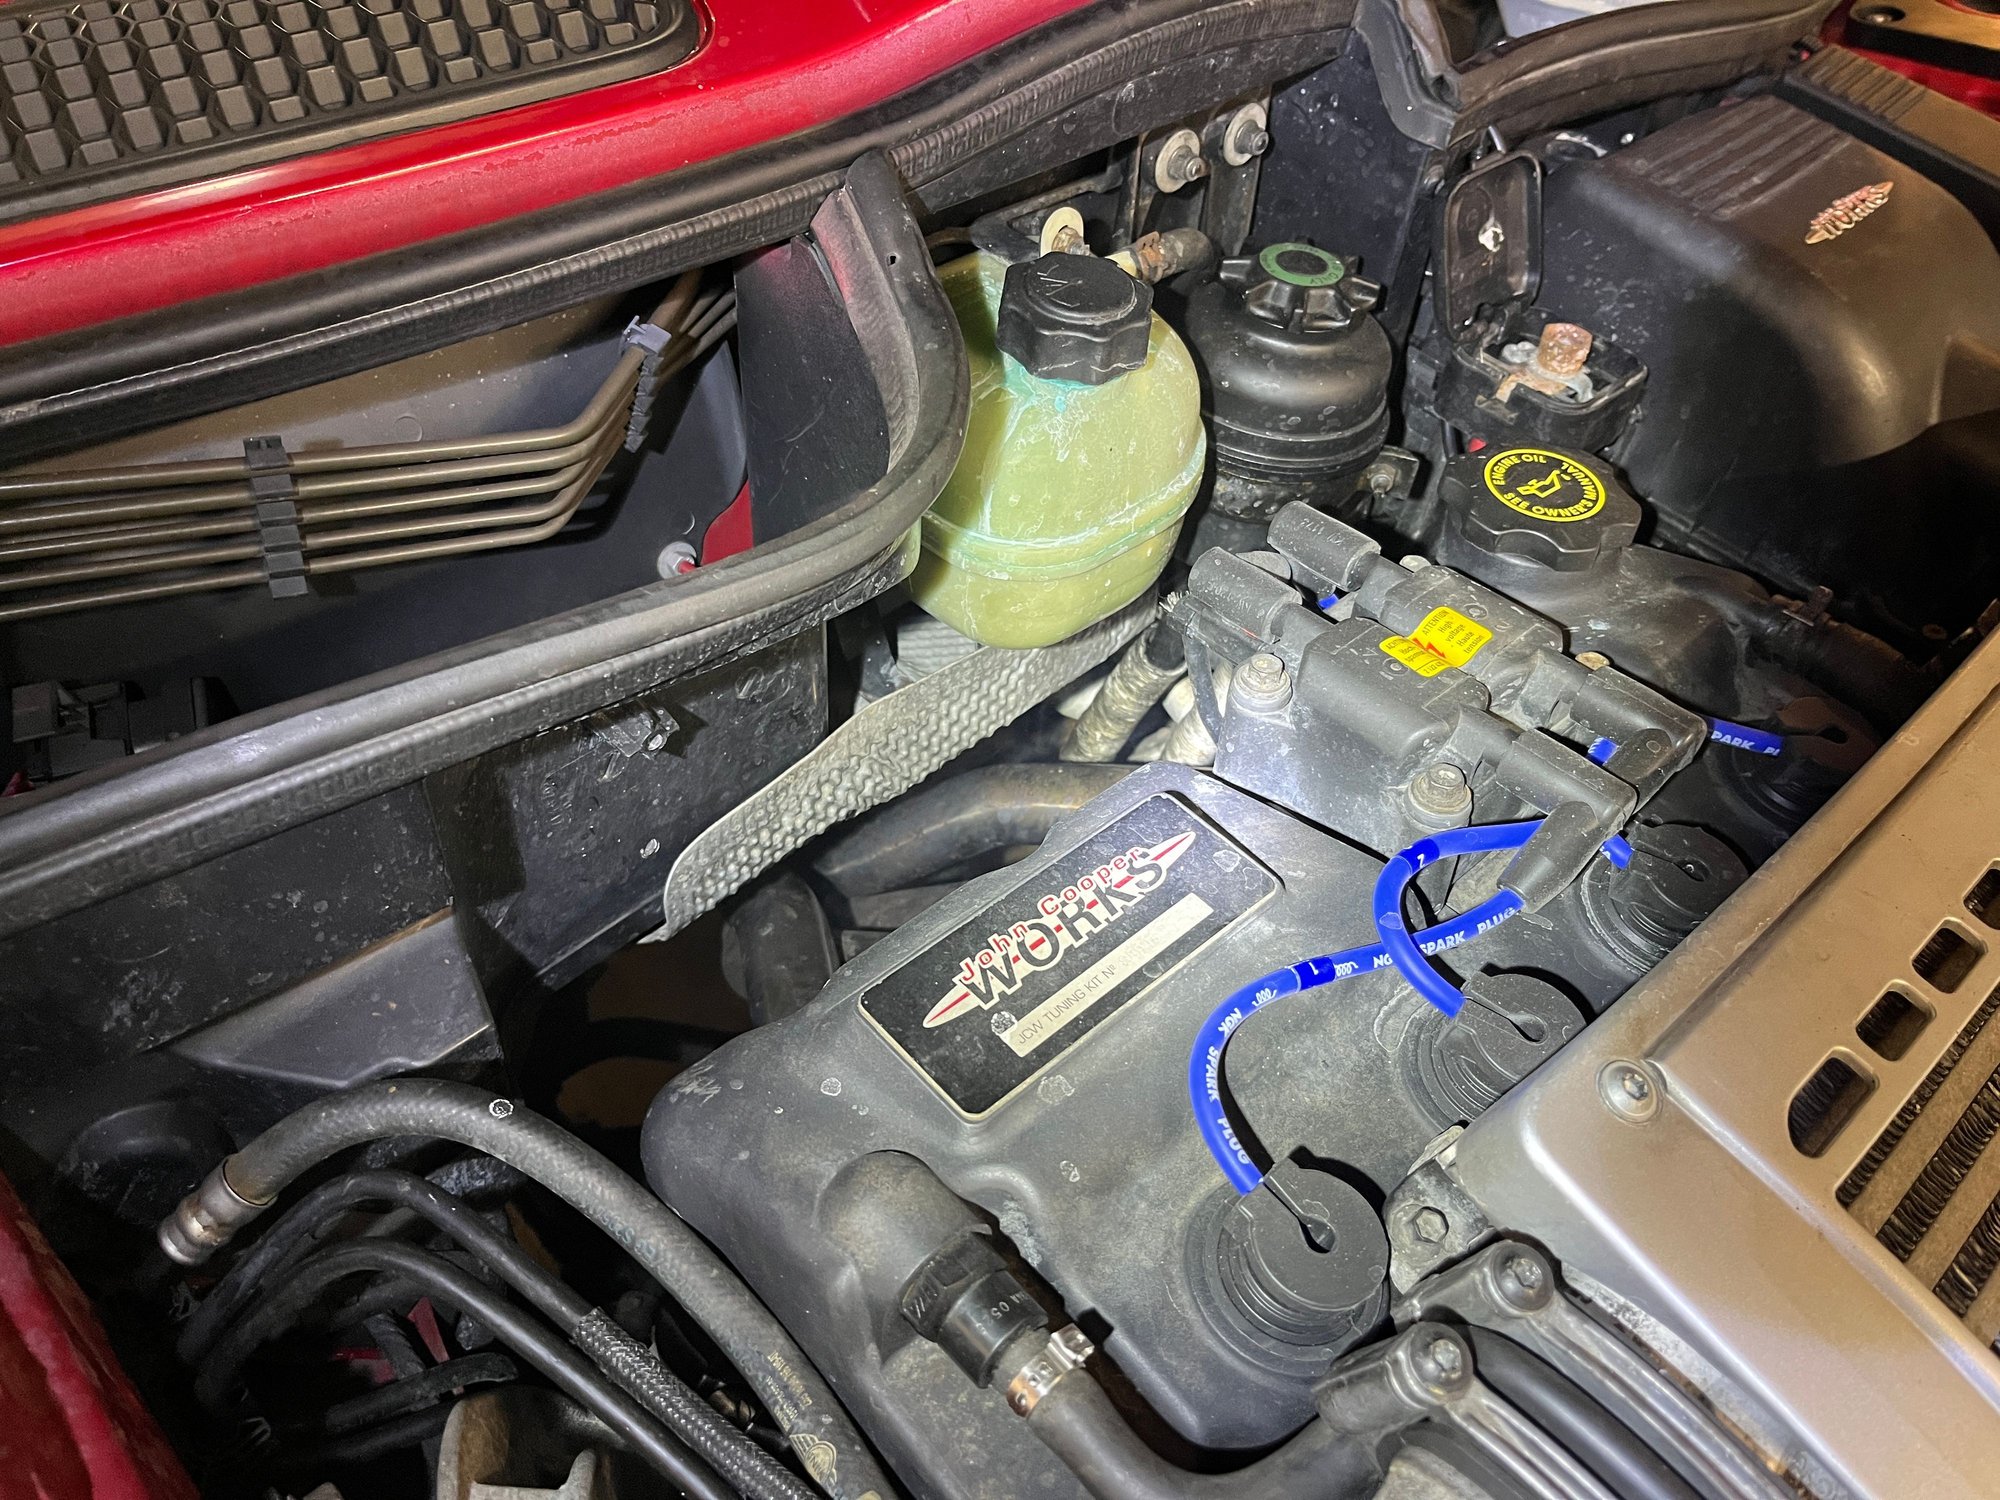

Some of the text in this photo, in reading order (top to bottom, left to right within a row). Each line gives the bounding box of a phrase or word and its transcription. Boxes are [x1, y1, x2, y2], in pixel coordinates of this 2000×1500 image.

[1492, 454, 1547, 485] ENGINE OIL
[1504, 462, 1597, 517] SEE OWNER'S MANUAL
[1422, 609, 1449, 636] ATTENTION
[1438, 620, 1453, 634] High
[1446, 624, 1465, 642] voltage
[1456, 631, 1475, 647] Haute
[1463, 635, 1485, 654] tension
[962, 848, 1139, 982] John Cooper
[964, 852, 1163, 1005] WORKS
[1373, 906, 1516, 969] NG SPARK PLUG
[1018, 1019, 1044, 1045] JCW
[1042, 988, 1086, 1023] TUNING
[1083, 974, 1102, 992] KIT
[1205, 1007, 1250, 1165] NGK SPARK PLUG
